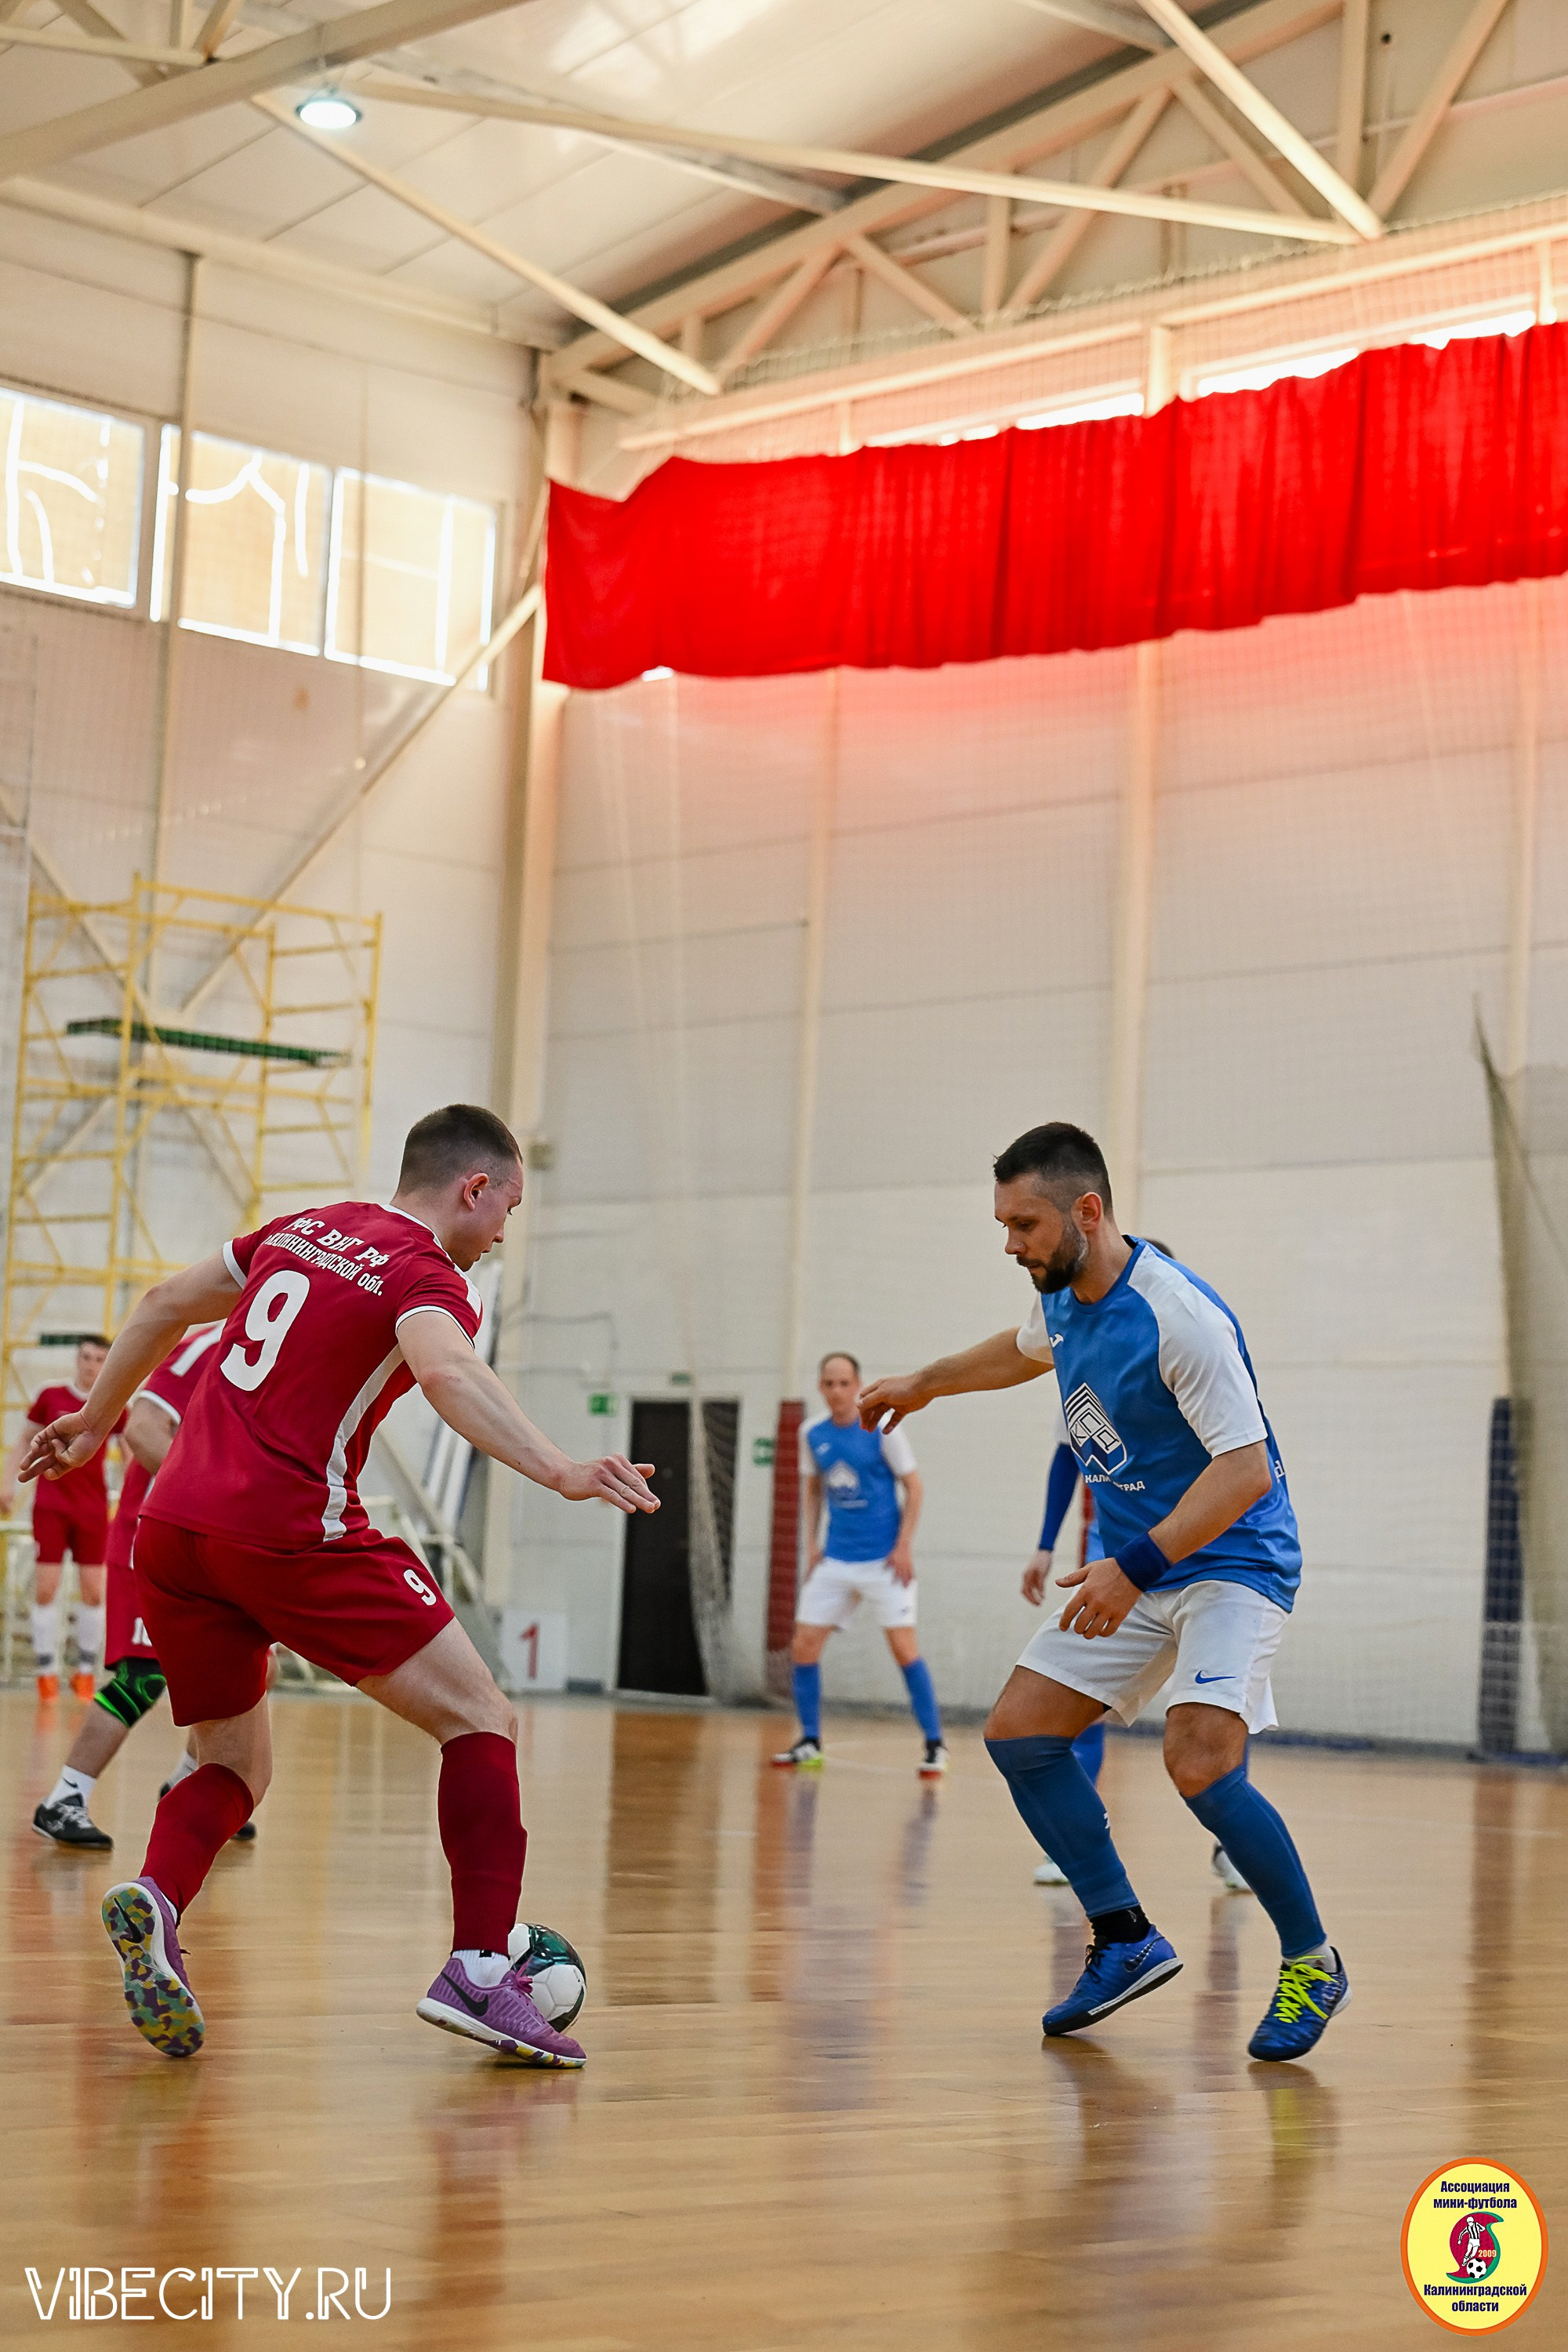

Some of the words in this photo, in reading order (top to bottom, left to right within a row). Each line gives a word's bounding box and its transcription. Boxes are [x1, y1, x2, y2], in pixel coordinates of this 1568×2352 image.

[264, 1232, 365, 1281] КАЛИНИНГРАДСКОЙ
[317, 1229, 364, 1252] ВНГ
[354, 1247, 390, 1267] РФ
[220, 1270, 310, 1391] 9
[403, 1569, 437, 1606] 9
[520, 1622, 539, 1679] 1
